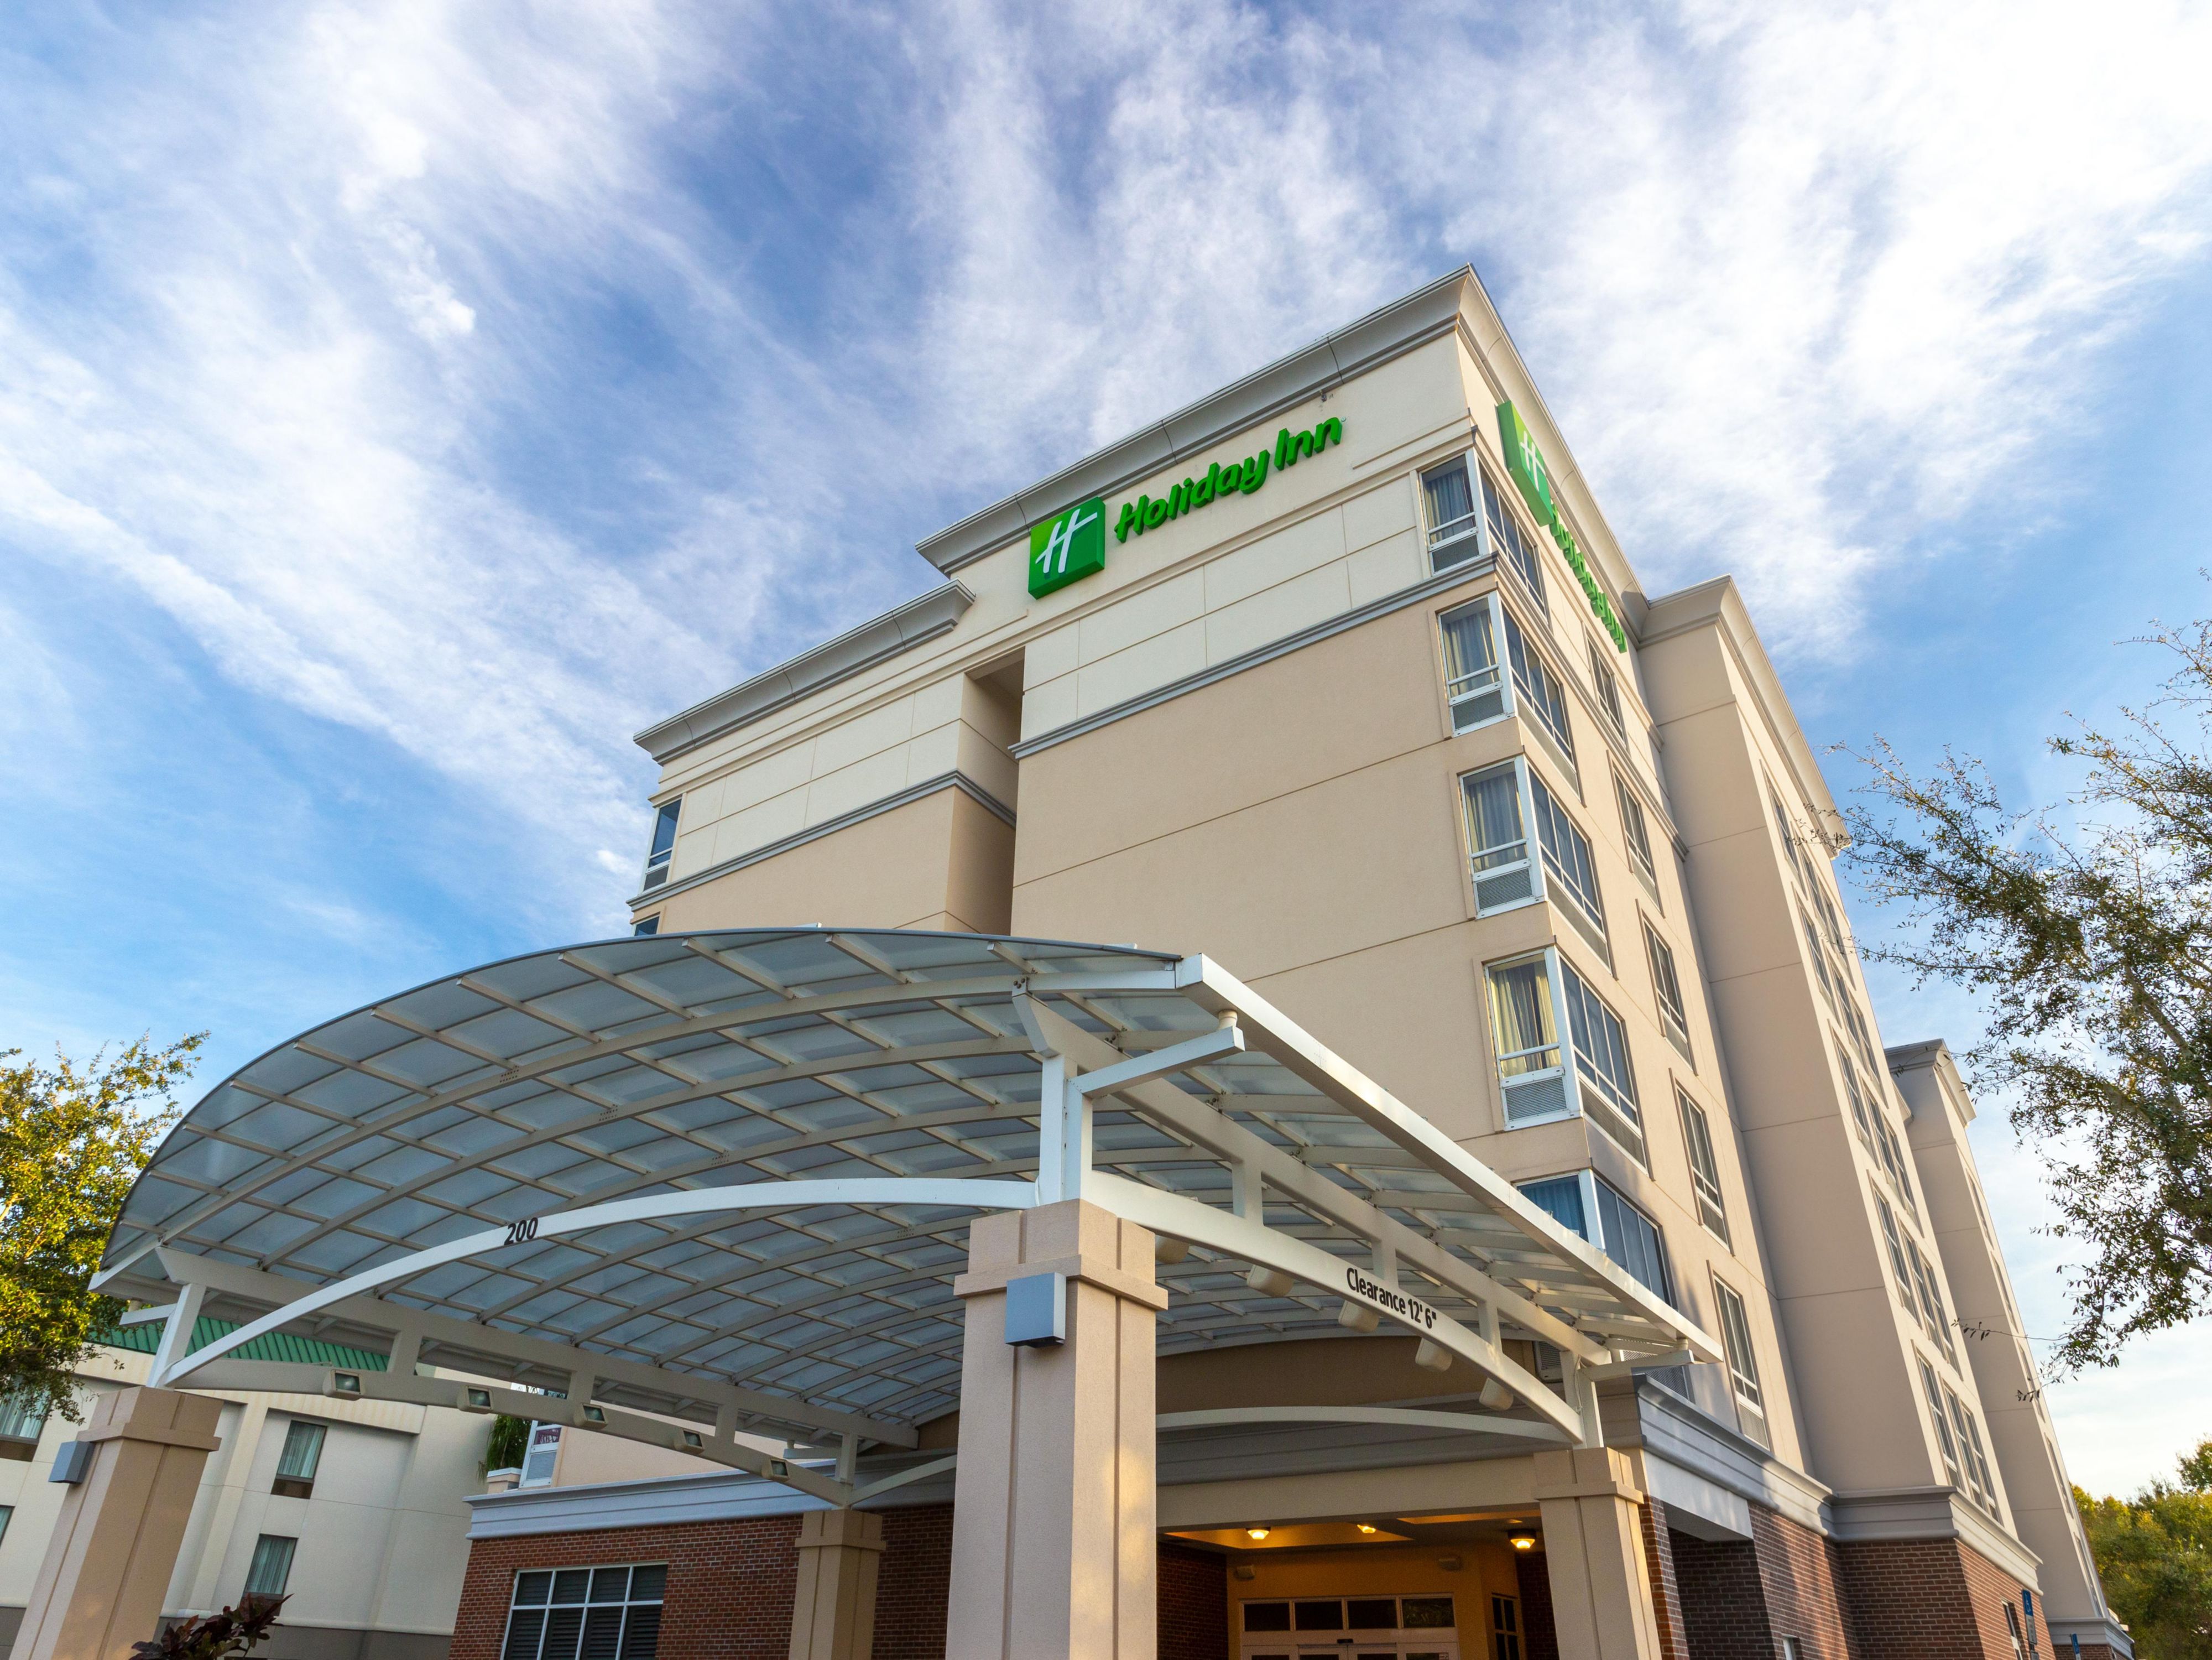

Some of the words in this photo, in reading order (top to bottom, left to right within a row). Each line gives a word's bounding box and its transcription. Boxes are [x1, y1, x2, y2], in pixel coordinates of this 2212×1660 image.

[1114, 449, 1270, 543] Holiday
[1274, 417, 1343, 471] Inn
[504, 1217, 538, 1246] 200
[1347, 1267, 1406, 1314] Clearance
[1408, 1298, 1423, 1323] 12'
[1425, 1308, 1437, 1329] 6"
